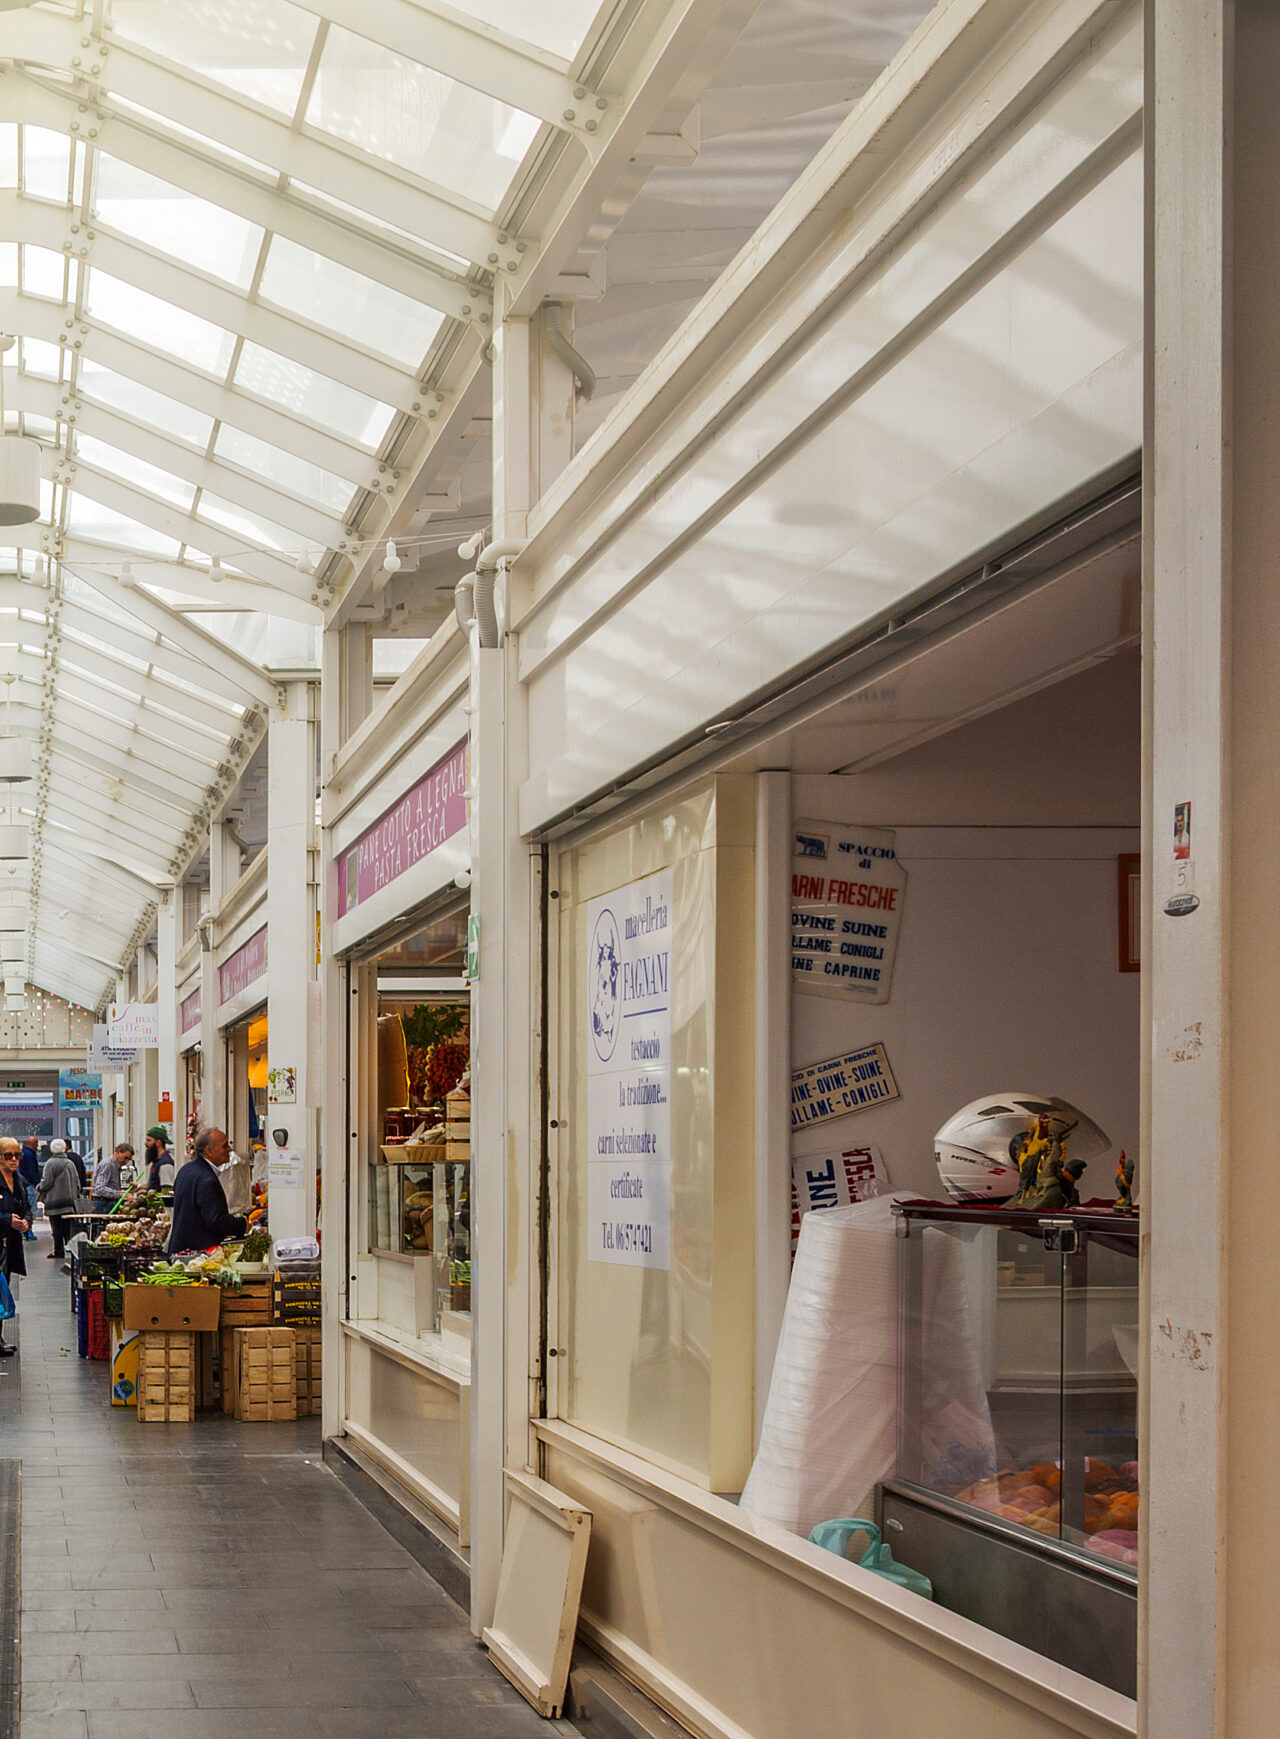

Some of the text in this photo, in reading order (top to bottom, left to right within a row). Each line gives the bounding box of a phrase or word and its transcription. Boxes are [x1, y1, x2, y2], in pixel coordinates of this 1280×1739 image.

[358, 752, 465, 874] PANE COTTO A LEGNA
[374, 807, 447, 892] PASTA FRESCA
[838, 842, 896, 860] SPACCIO
[858, 858, 871, 869] di
[827, 879, 899, 911] FRESCHE
[625, 895, 667, 940] macelleria
[841, 920, 888, 939] SUINE
[841, 942, 884, 960] CONIGLI
[623, 952, 669, 1001] FAGNANI
[824, 961, 881, 981] CAPRINE
[631, 1031, 660, 1062] testaccio
[807, 1069, 816, 1077] DI
[817, 1061, 842, 1073] CARNI
[844, 1048, 877, 1065] FRESCHE
[619, 1080, 626, 1107] la
[598, 1127, 656, 1155] carni selezionate e
[610, 1171, 643, 1199] certificate
[602, 1222, 615, 1249] Tel.
